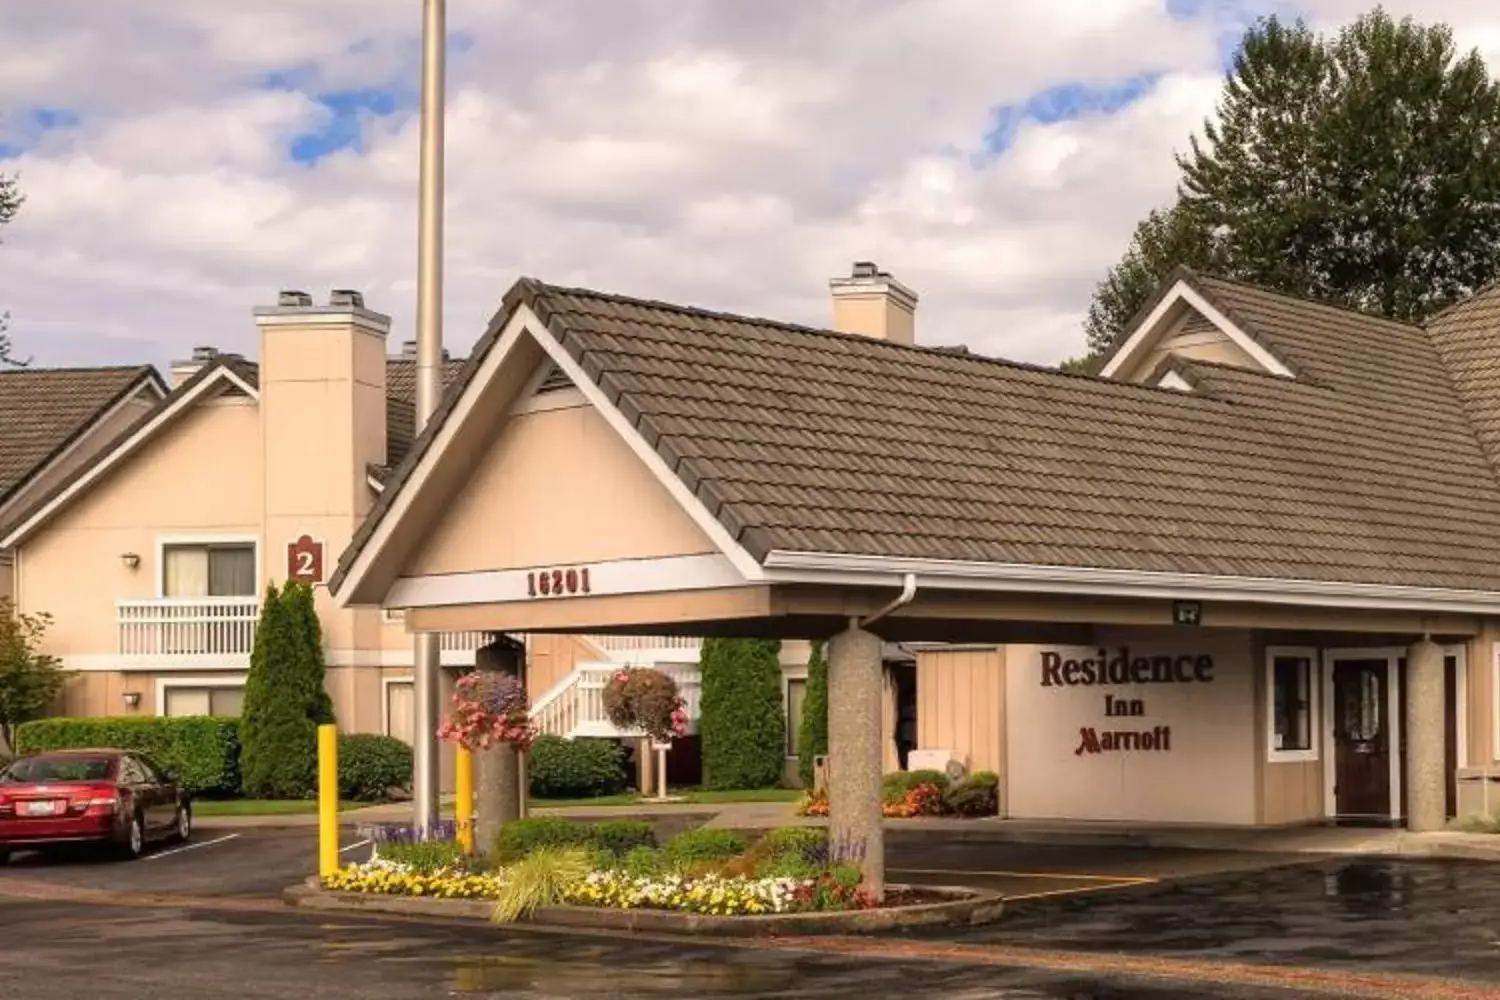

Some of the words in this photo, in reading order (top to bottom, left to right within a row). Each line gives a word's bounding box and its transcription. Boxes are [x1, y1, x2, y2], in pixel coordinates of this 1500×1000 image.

[296, 552, 315, 575] 2
[527, 567, 591, 597] 16201
[1039, 645, 1214, 687] Residence
[1104, 694, 1146, 717] Inn
[1074, 725, 1171, 756] Marriott
